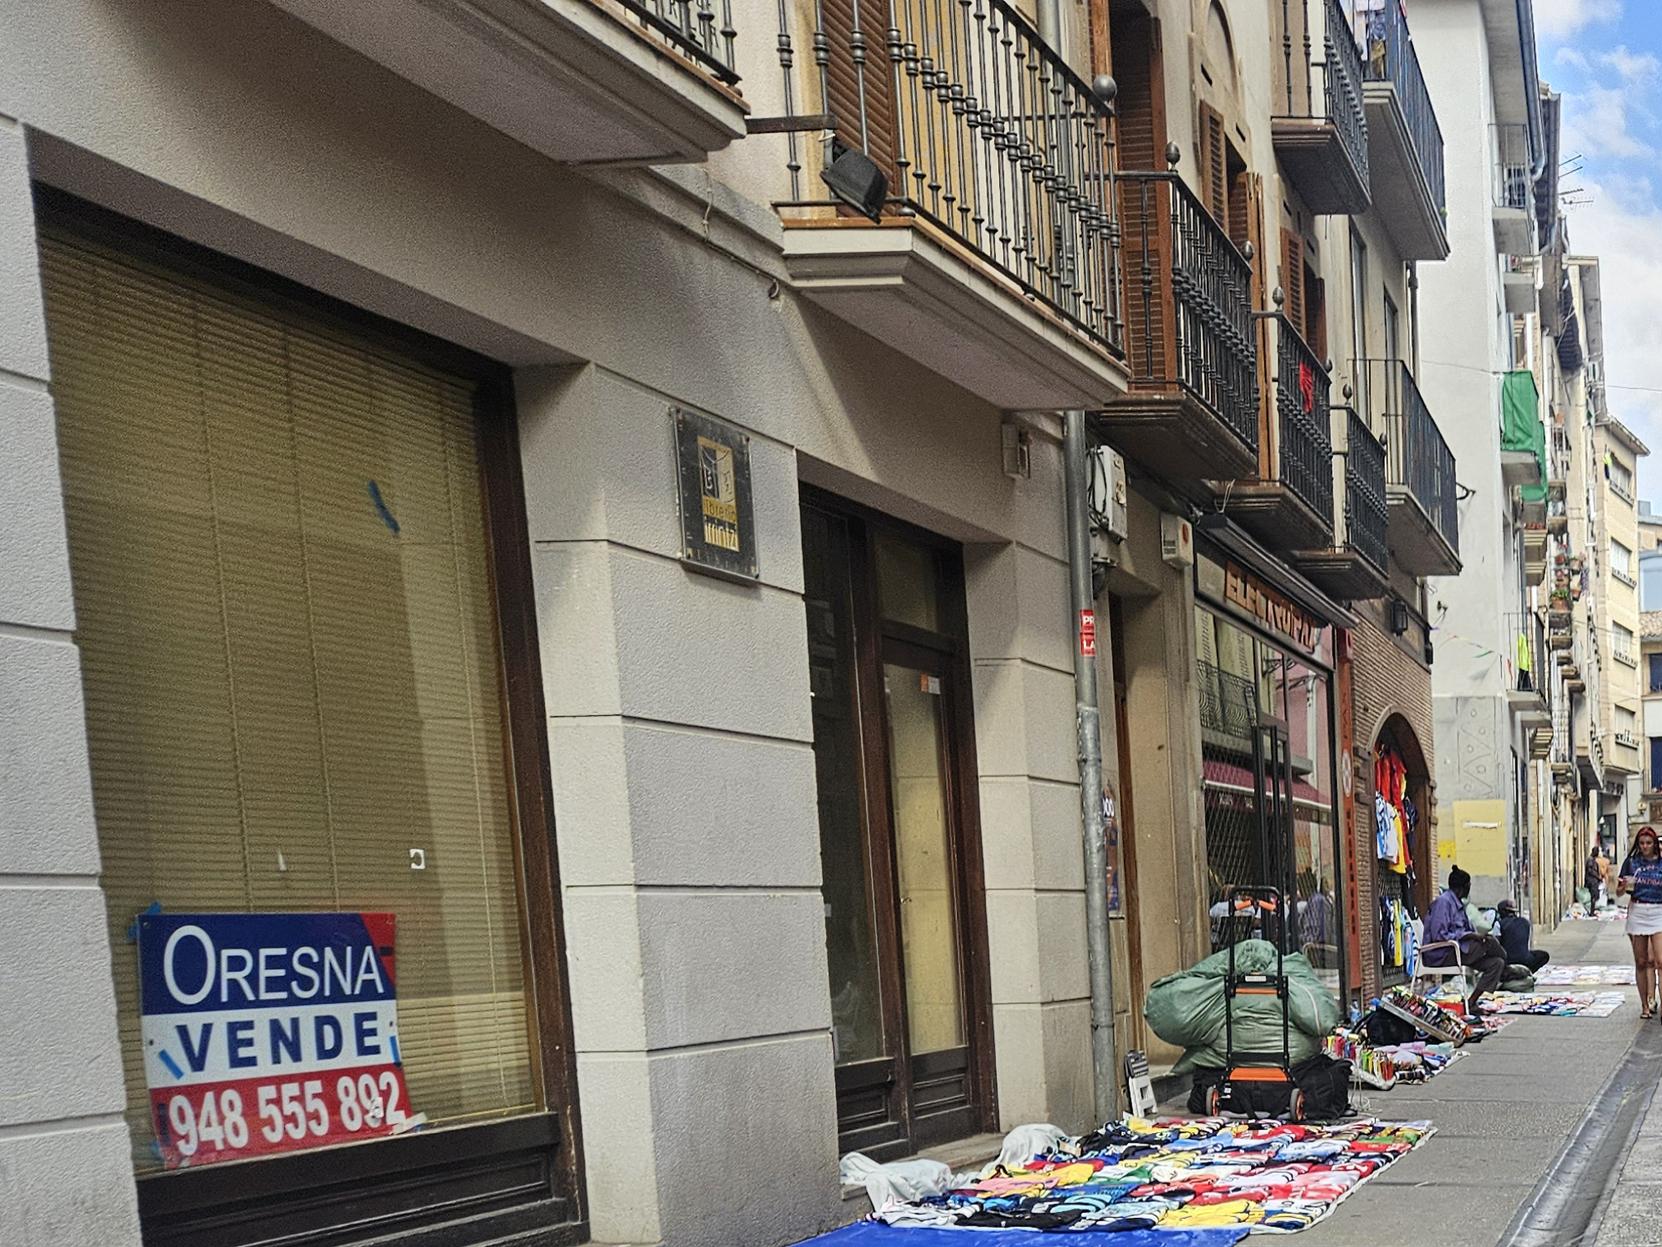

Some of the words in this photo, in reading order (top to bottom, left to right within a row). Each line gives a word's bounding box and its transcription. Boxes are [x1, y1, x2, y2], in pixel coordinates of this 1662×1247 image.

[163, 924, 385, 1005] ORESNA
[175, 1011, 381, 1073] VENDE
[168, 1089, 249, 1156] 948
[257, 1079, 329, 1144] 555
[336, 1071, 406, 1133] 892
